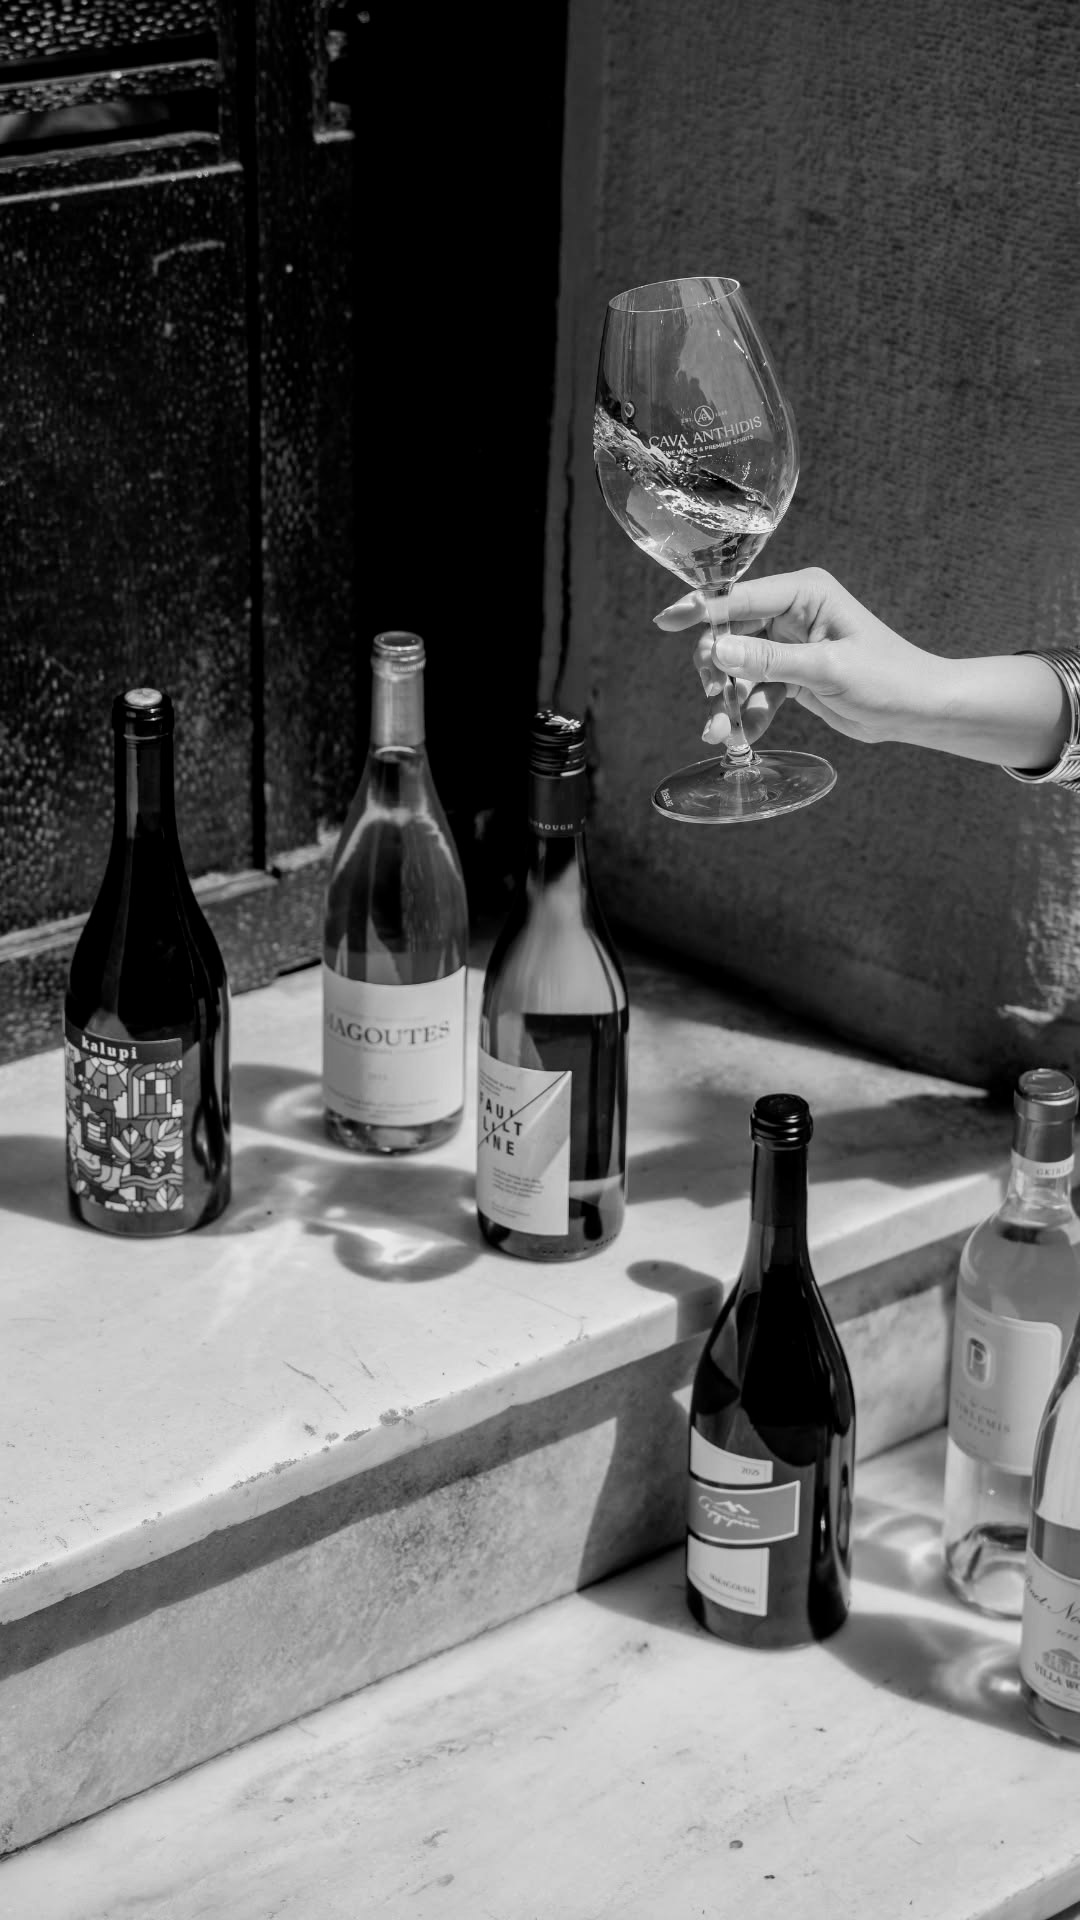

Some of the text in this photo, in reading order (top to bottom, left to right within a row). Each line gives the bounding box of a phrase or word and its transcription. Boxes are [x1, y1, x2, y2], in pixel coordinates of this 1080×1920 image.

[648, 416, 762, 449] CAVA ANTHIDIS
[704, 440, 732, 451] PREMIUM
[732, 434, 755, 446] SPIRITS
[81, 1035, 138, 1062] kalupi
[1034, 1661, 1062, 1686] VILLA
